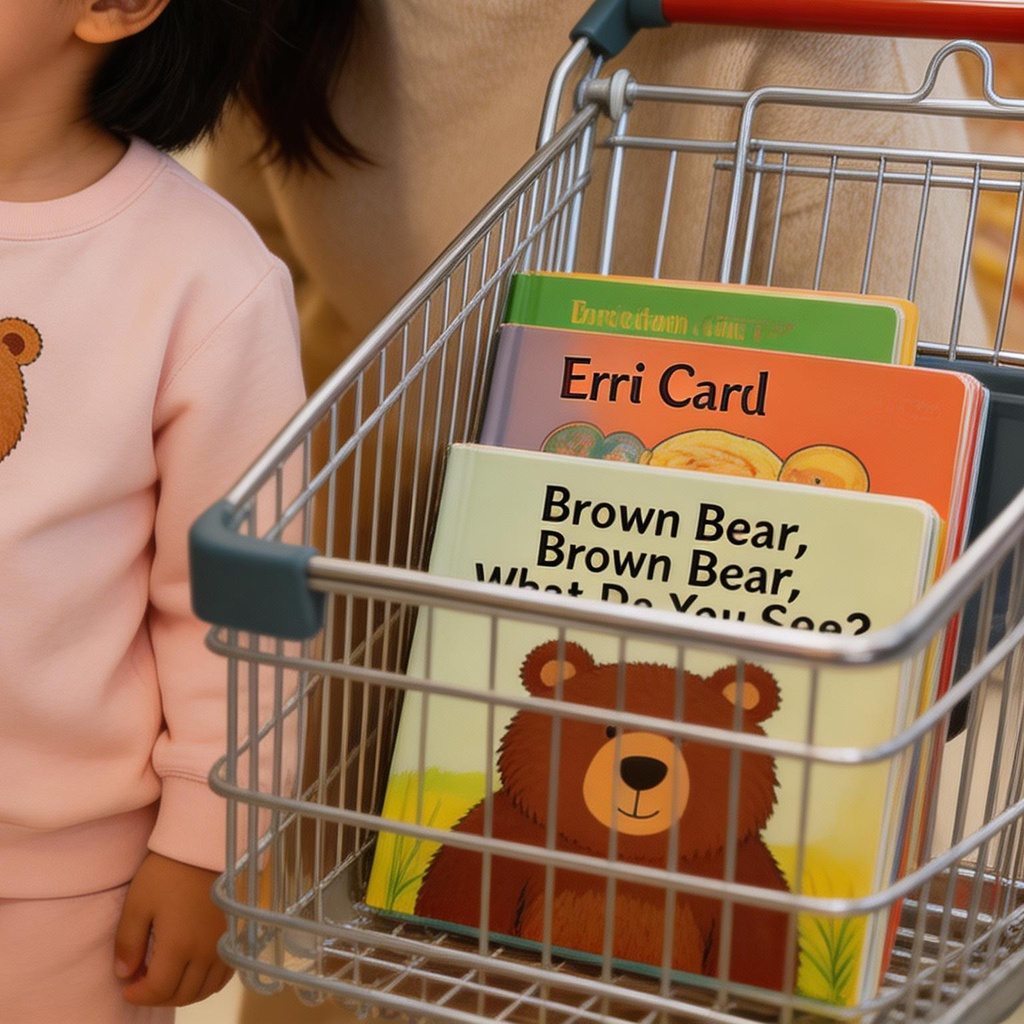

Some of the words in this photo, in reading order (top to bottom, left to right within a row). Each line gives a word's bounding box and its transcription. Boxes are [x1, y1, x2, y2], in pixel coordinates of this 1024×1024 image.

[560, 356, 645, 404] Erri
[659, 363, 769, 417] Card
[541, 484, 681, 538] Brown
[695, 502, 808, 560] Bear,
[536, 529, 672, 583] Brown
[688, 548, 801, 604] Bear,
